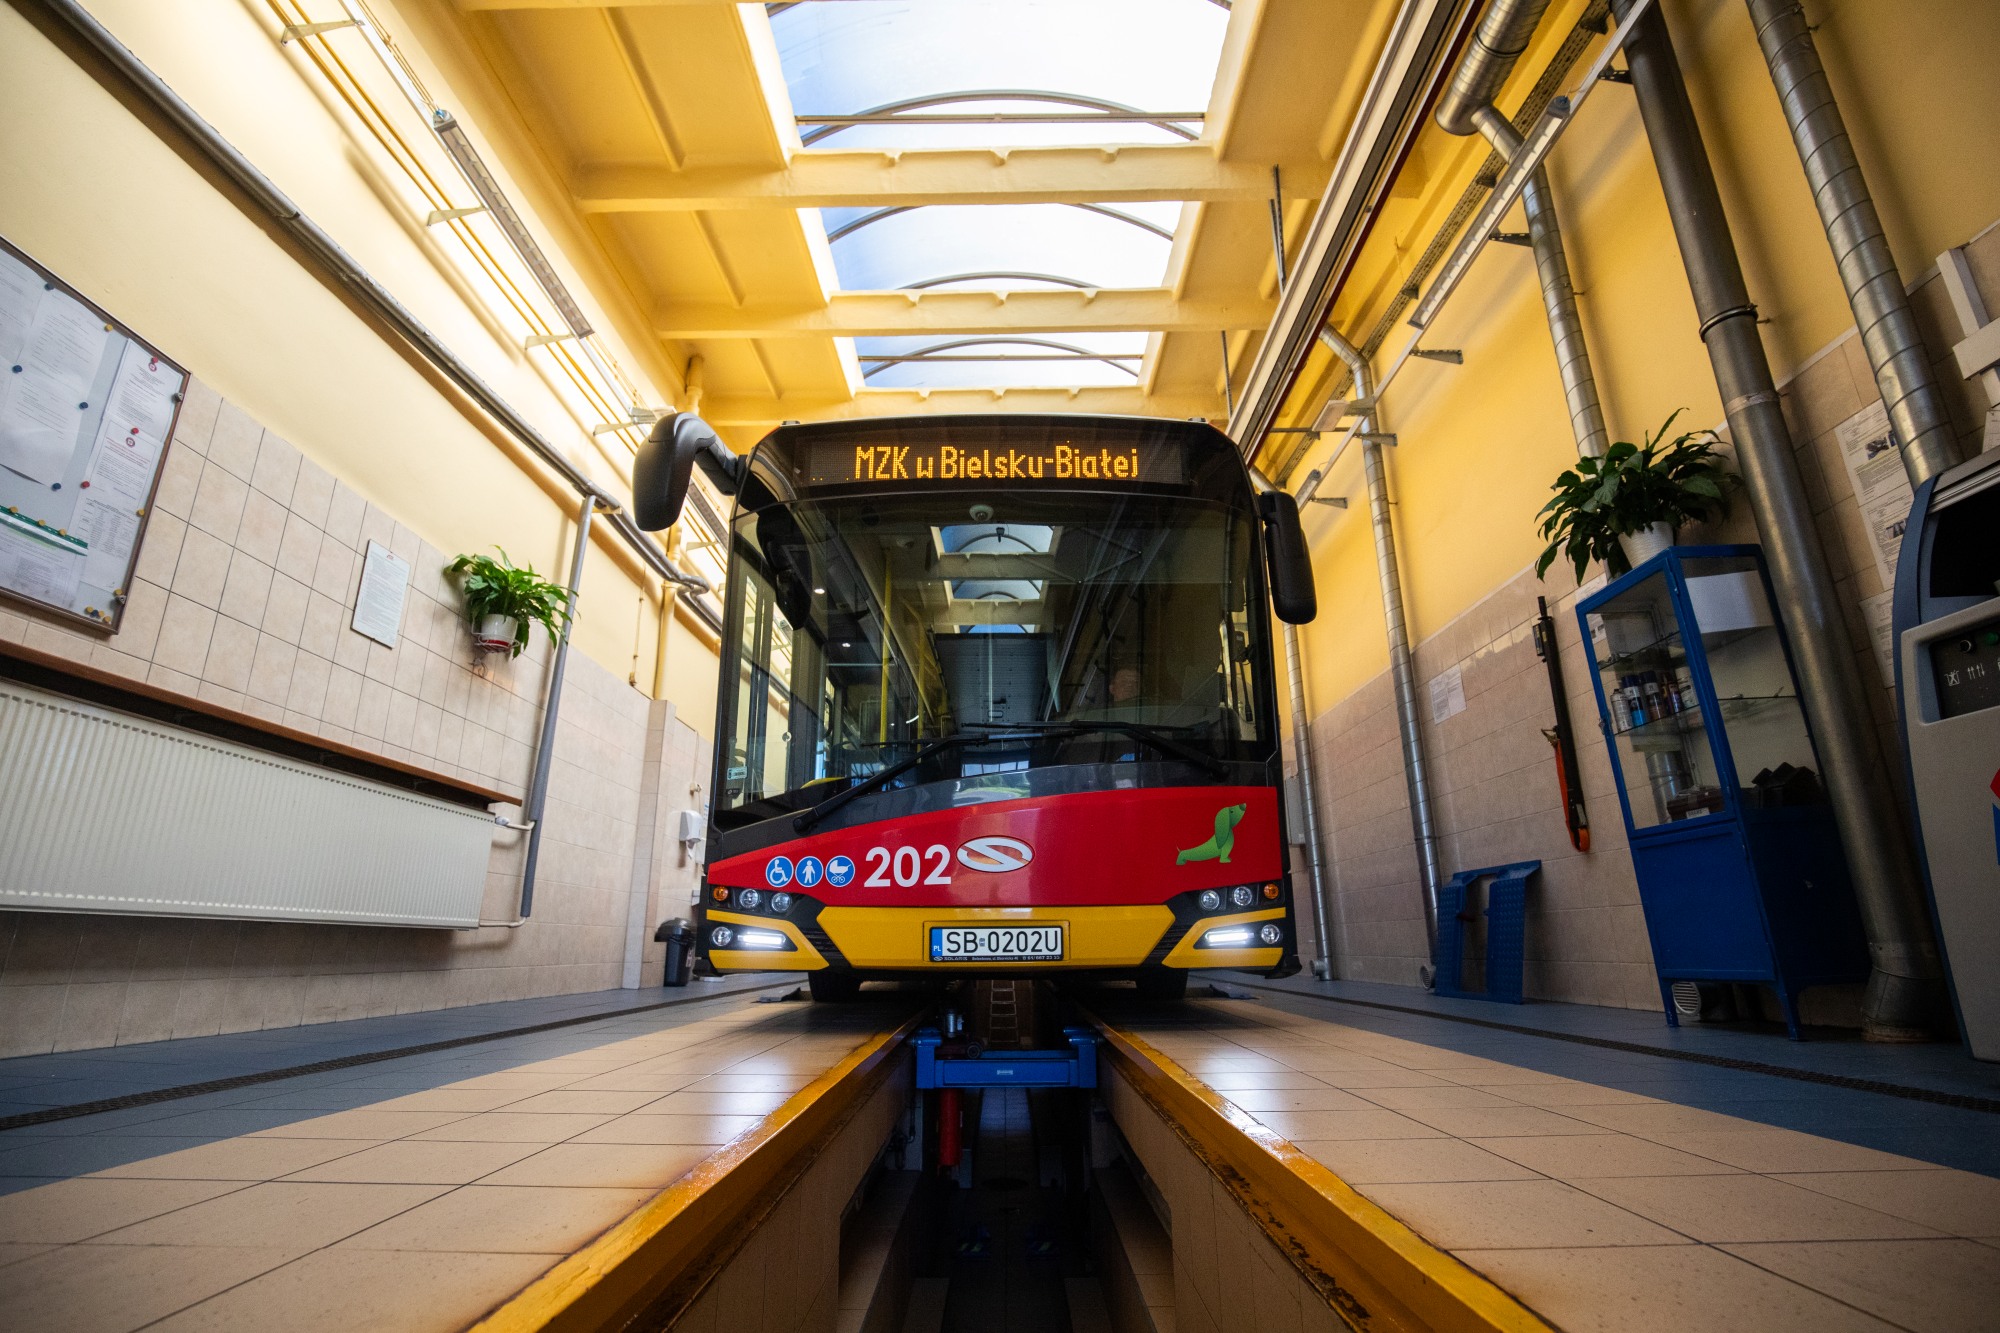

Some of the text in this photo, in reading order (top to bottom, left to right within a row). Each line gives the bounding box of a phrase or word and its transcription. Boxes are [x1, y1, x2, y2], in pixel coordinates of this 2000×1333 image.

[855, 445, 1138, 479] MZK w Bielsku-Białej
[864, 844, 952, 888] 202
[946, 931, 978, 953] SB
[987, 930, 1058, 953] 0202U
